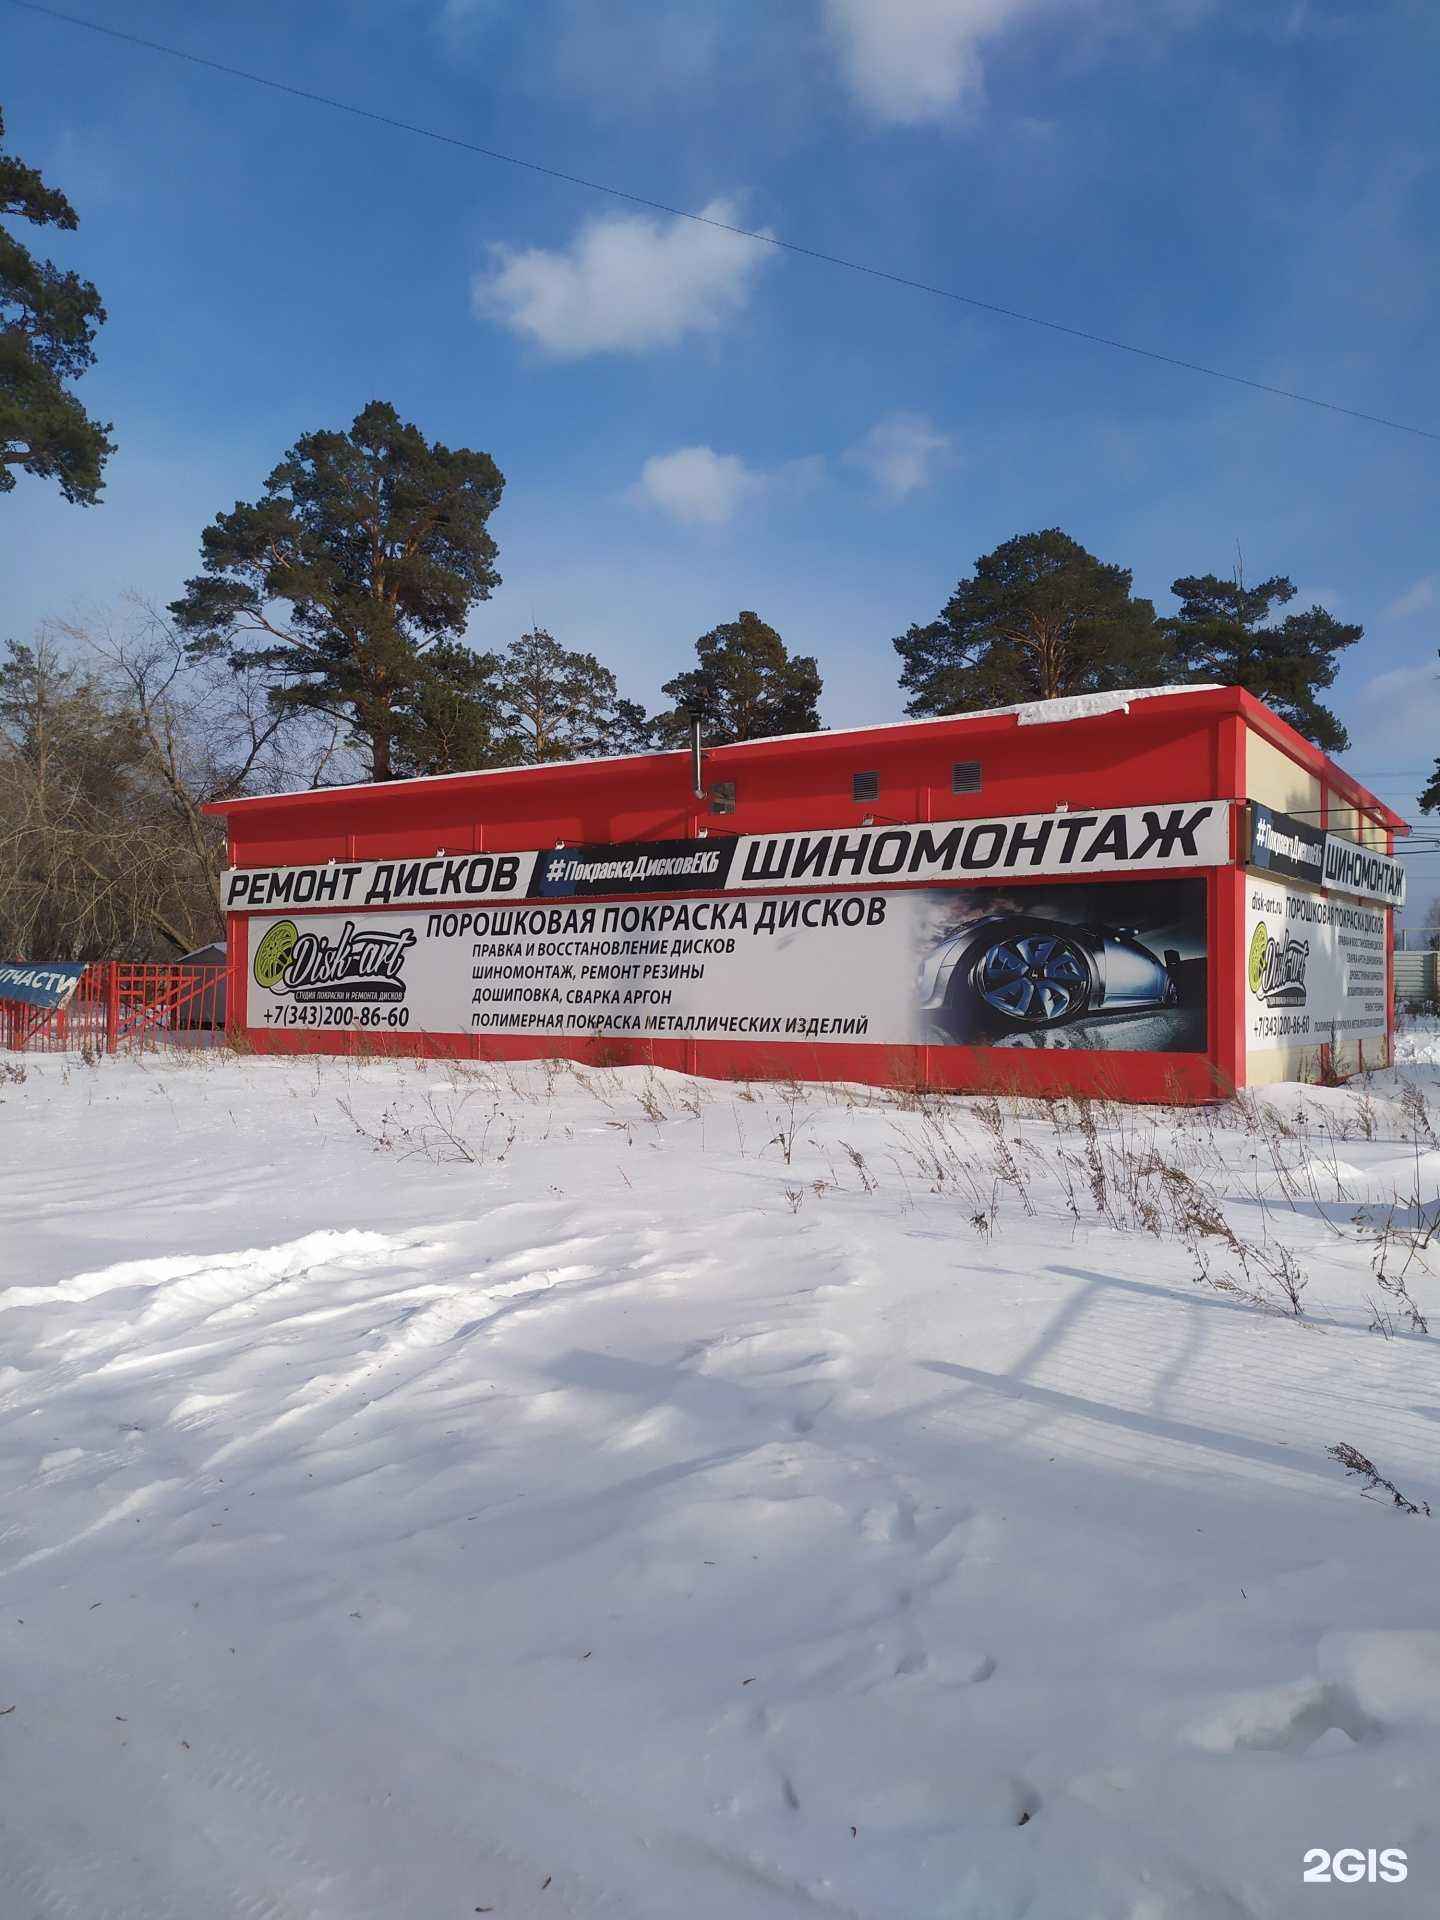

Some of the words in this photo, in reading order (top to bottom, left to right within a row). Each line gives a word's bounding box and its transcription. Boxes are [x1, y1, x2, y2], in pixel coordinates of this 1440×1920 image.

[741, 806, 1213, 881] ШИНОМОНТАЖ
[227, 867, 362, 906] РЕМОНТ
[364, 856, 521, 904] ДИСКОВ
[546, 850, 721, 883] #ПокраскаДисковЕКБ
[1325, 843, 1404, 898] ШИНОМОНТАЖ
[426, 908, 597, 938] ПОРОШКОВАЯ
[601, 902, 748, 932] ПОКРАСКА
[753, 897, 887, 935] ДИСКОВ
[1285, 896, 1334, 926] ПОРОШКОВАЯ
[284, 922, 416, 986] Disk-art
[472, 943, 522, 957] ПРАВКА
[525, 943, 535, 957] И
[537, 939, 668, 956] ВОССТАНОВЛЕНИЕ
[670, 938, 735, 957] ДИСКОВ
[472, 965, 576, 981] ШИНОМОНТАЖ,
[581, 964, 640, 979] РЕМОНТ
[643, 964, 704, 979] РЕЗИНЫ
[351, 991, 378, 1000] РЕМОНТА
[378, 991, 403, 1001] ДИСКОВ
[471, 988, 562, 1004] ДОШИПОВКА,
[566, 989, 620, 1004] СВАРКА
[623, 989, 672, 1004] АРГОН
[264, 1005, 410, 1027] +7(343)200-86-60
[471, 1013, 563, 1028] ПОЛИМЕРНАЯ
[566, 1014, 641, 1030] ПОКРАСКА
[644, 1015, 782, 1032] МЕТАЛЛИЧЕСКИХ
[785, 1015, 868, 1035] ИЗДЕЛИЙ
